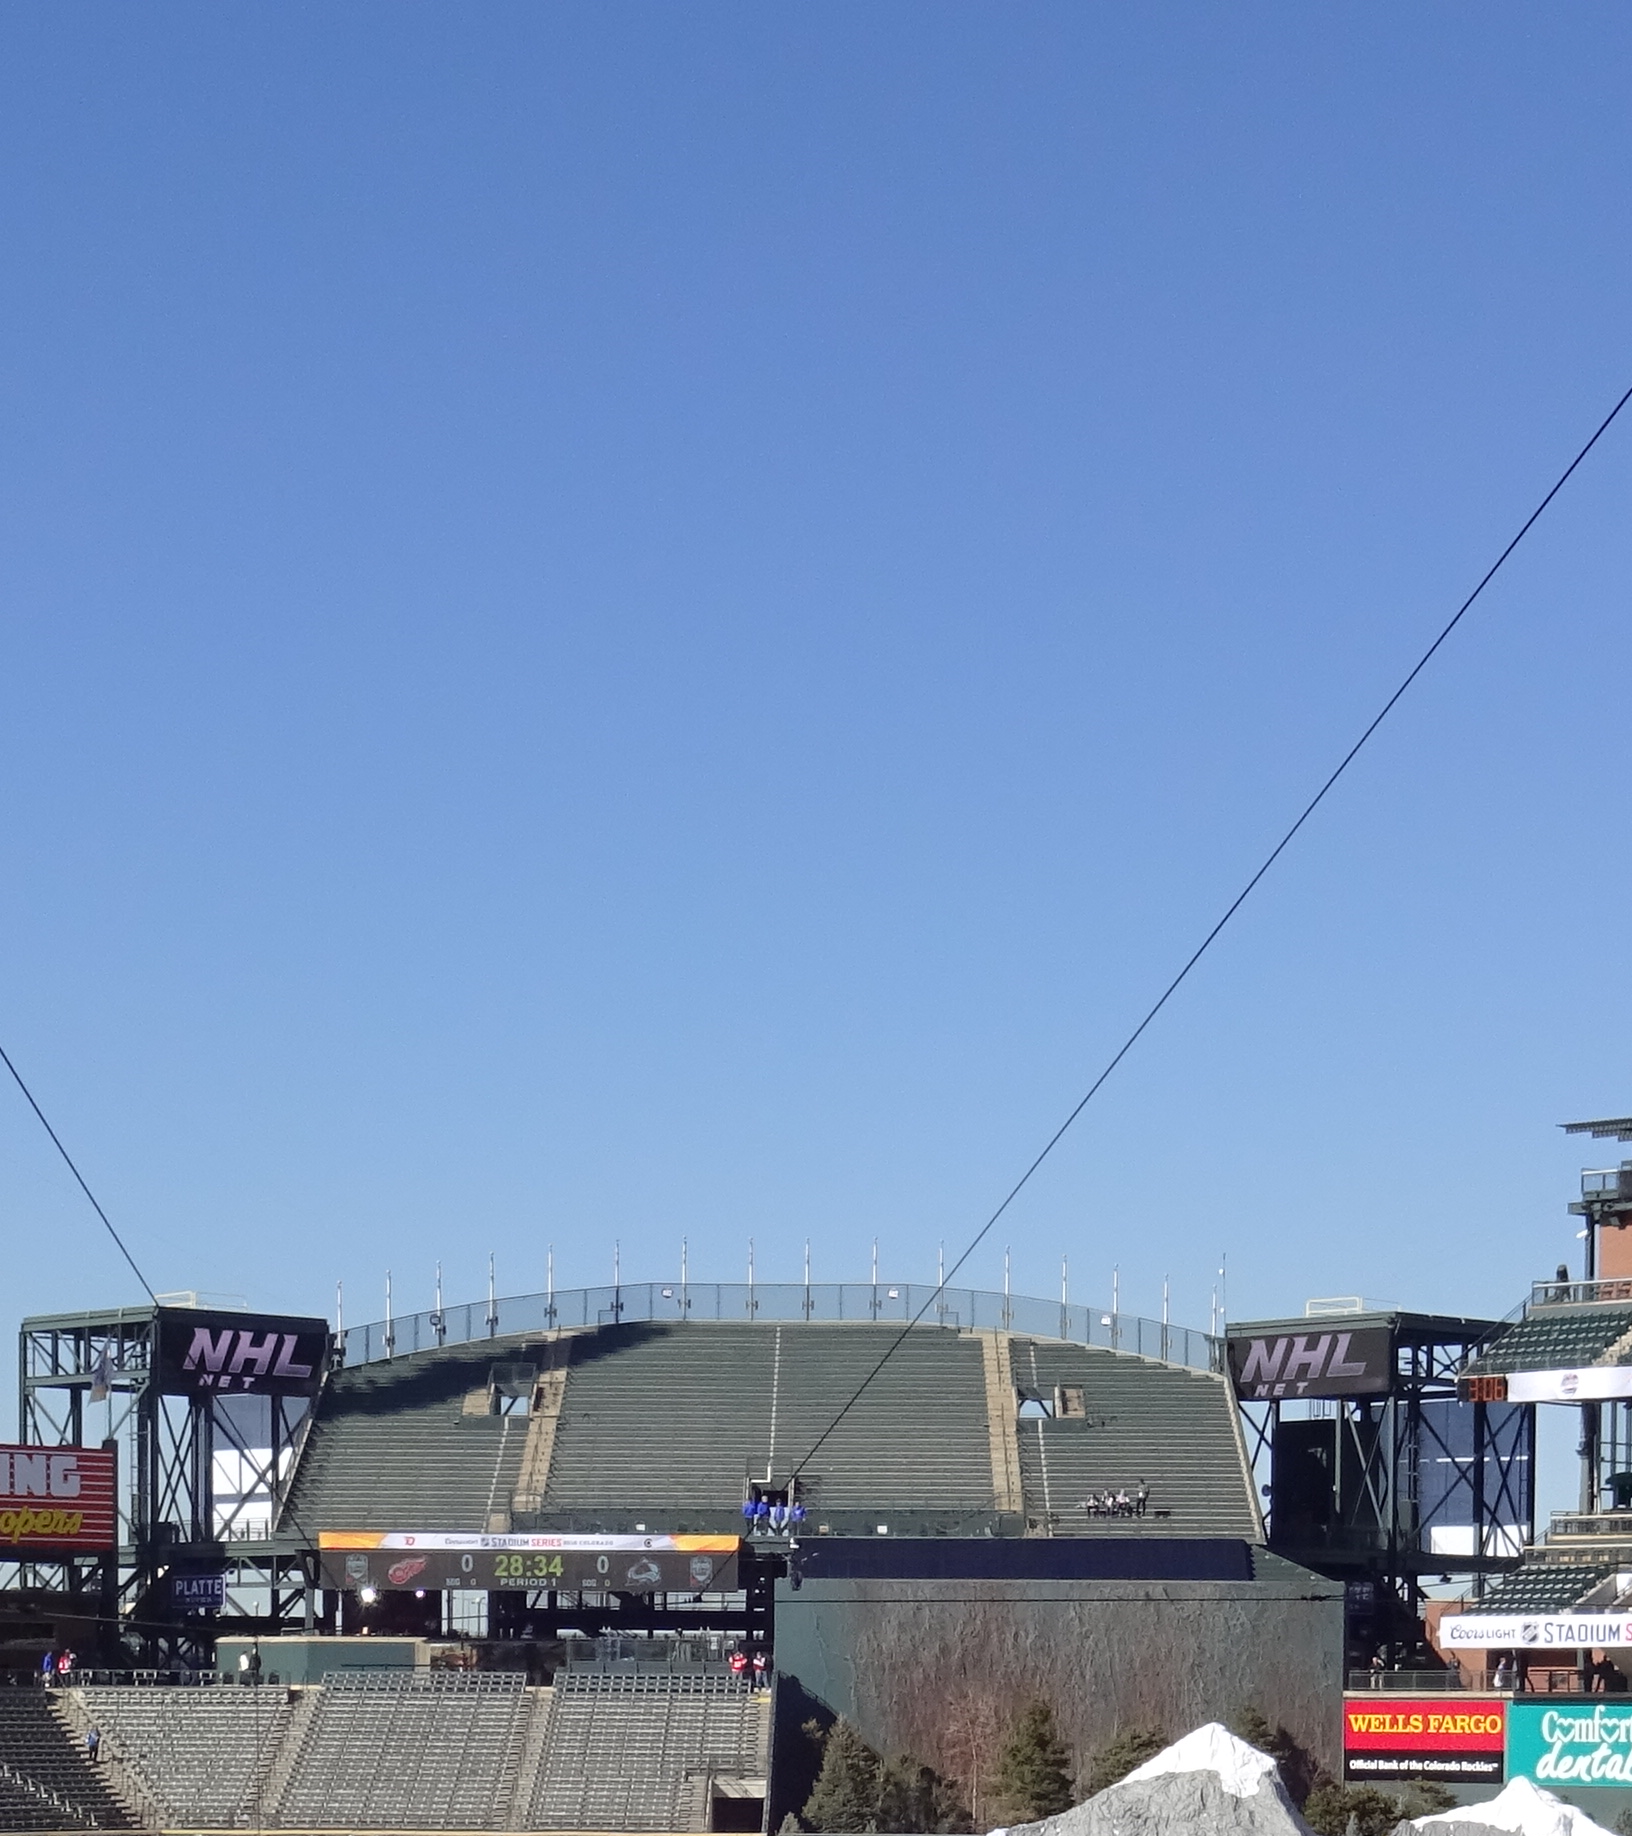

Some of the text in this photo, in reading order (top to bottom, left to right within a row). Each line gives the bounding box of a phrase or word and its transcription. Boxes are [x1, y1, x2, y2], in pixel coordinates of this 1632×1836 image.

[183, 1327, 313, 1378] NHL
[1240, 1332, 1367, 1383] NHL
[198, 1374, 256, 1389] NET
[1254, 1381, 1308, 1397] NET
[1470, 1376, 1505, 1400] 3:06
[491, 1537, 562, 1548] STADIUM SERIES
[461, 1554, 609, 1577] 0 28:34 0
[175, 1579, 222, 1596] PLATTE
[500, 1578, 556, 1587] PERIOD 1
[1450, 1623, 1485, 1640] Coors
[1486, 1628, 1516, 1640] LIGHT
[1544, 1622, 1621, 1644] STADIUM
[1348, 1714, 1502, 1733] WELLS FARGO
[1349, 1759, 1460, 1771] Official Bank of the Colorado
